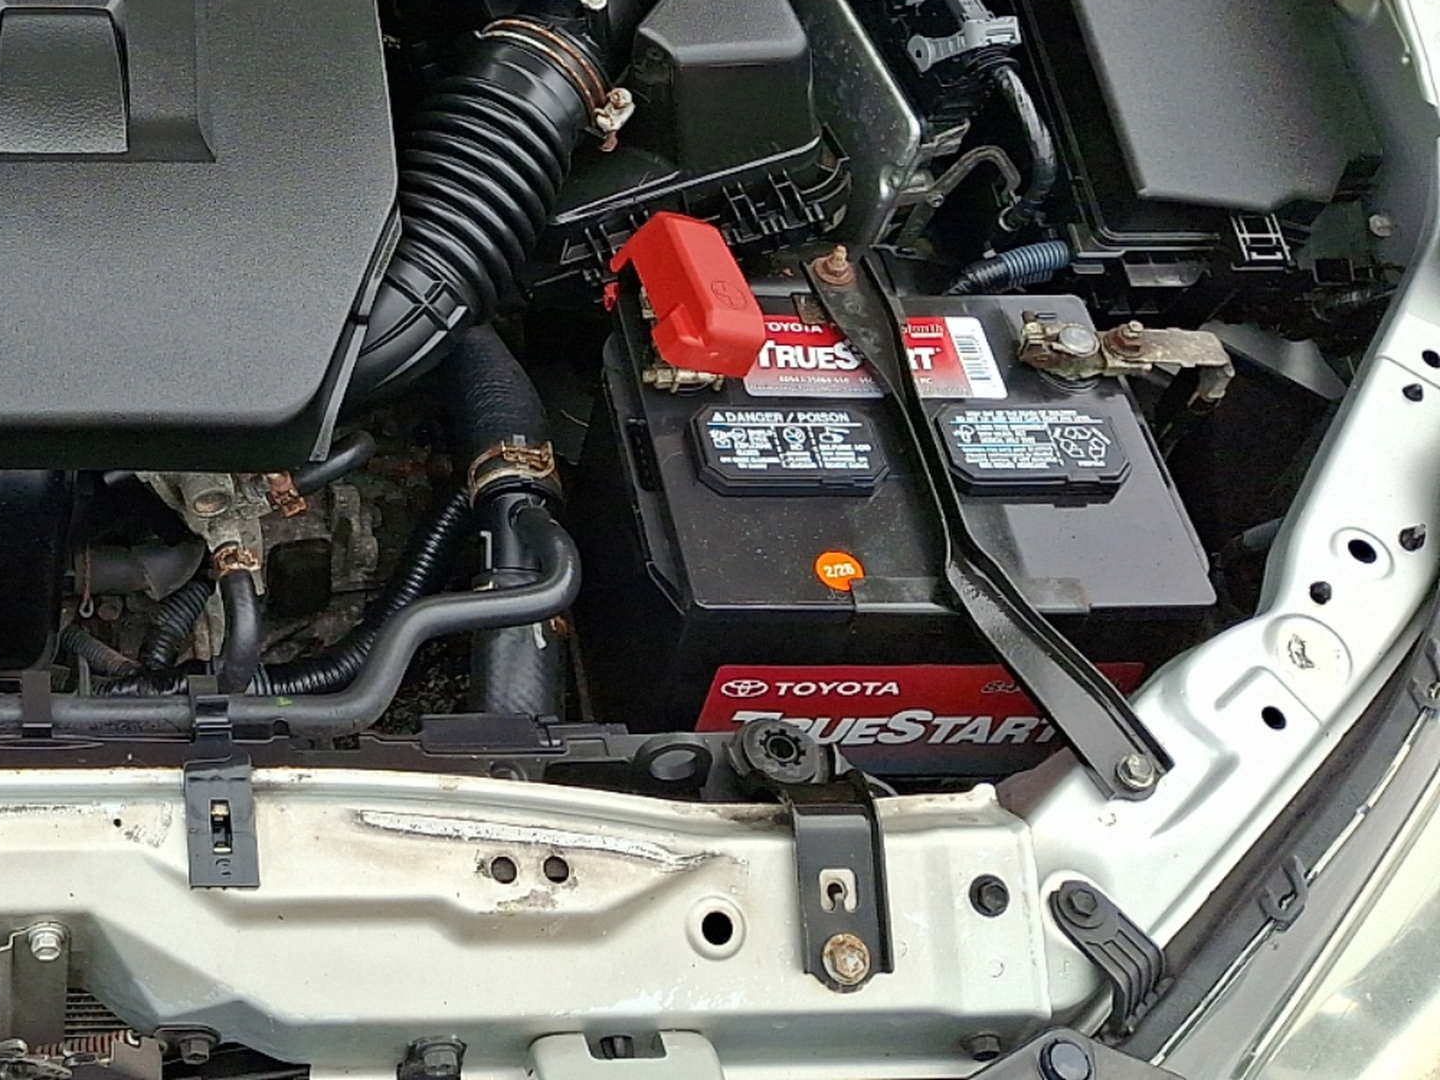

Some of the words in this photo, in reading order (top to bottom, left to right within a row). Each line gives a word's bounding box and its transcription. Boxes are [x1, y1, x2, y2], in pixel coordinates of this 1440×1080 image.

[765, 321, 823, 333] OYOTA
[759, 339, 936, 370] TRUEST
[725, 411, 784, 423] DANGER
[796, 411, 850, 423] POISON
[775, 682, 900, 696] TOYOTA
